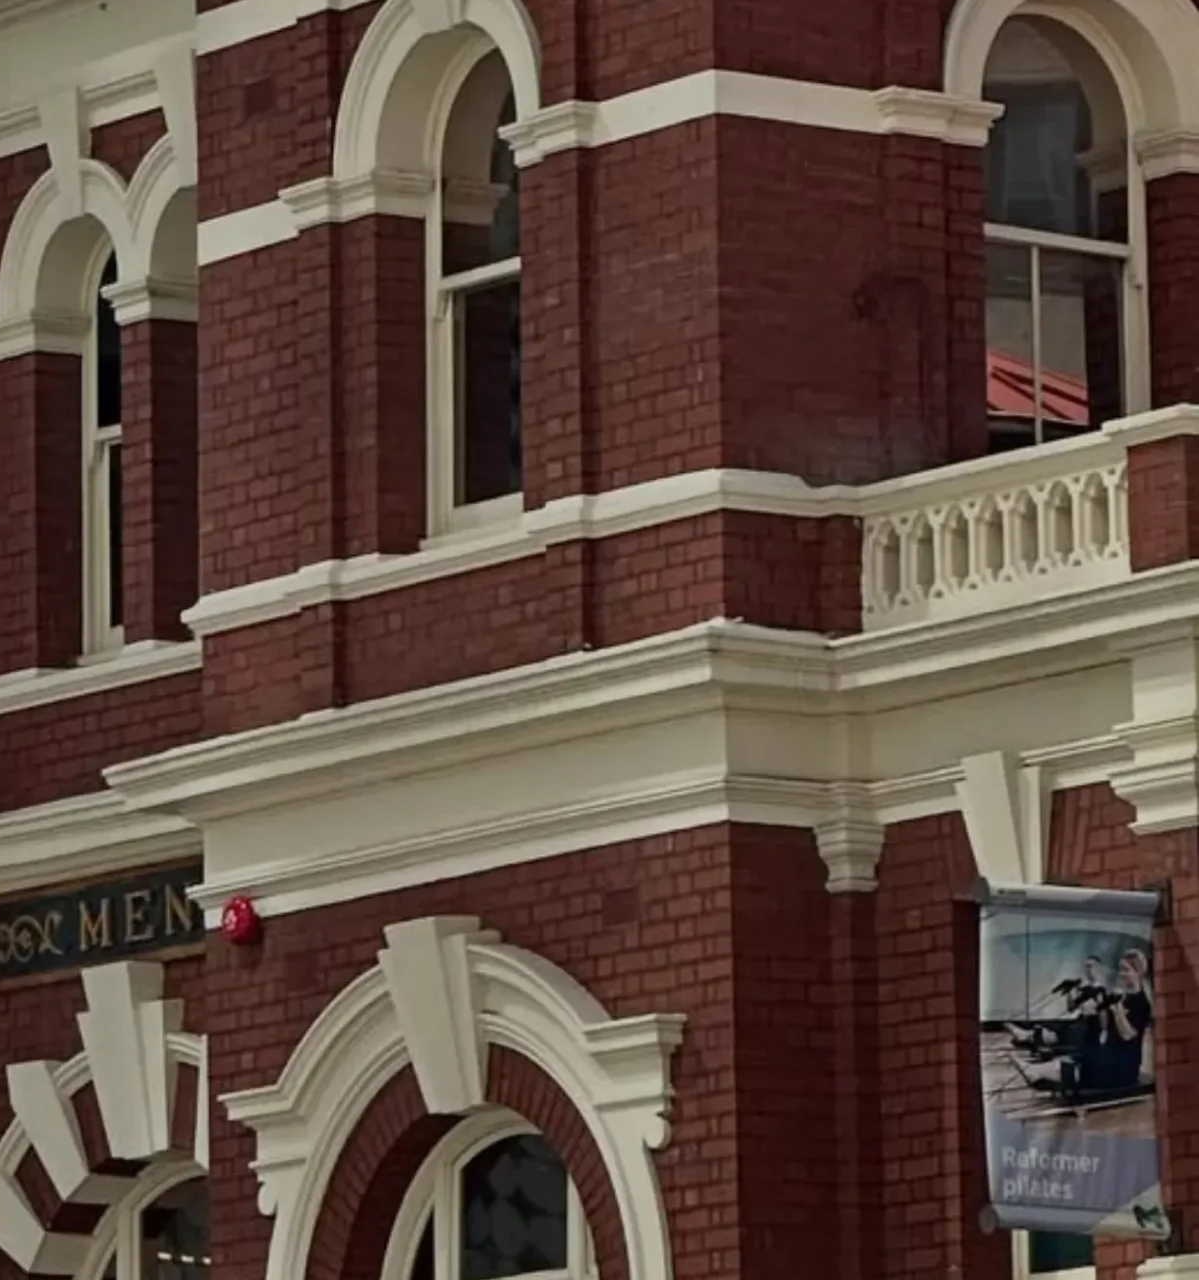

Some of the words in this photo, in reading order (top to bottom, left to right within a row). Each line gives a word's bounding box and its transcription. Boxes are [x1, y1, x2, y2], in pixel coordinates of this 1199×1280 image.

[77, 882, 194, 953] MEN
[1002, 1146, 1101, 1174] Reformer
[1003, 1174, 1075, 1202] pilates
